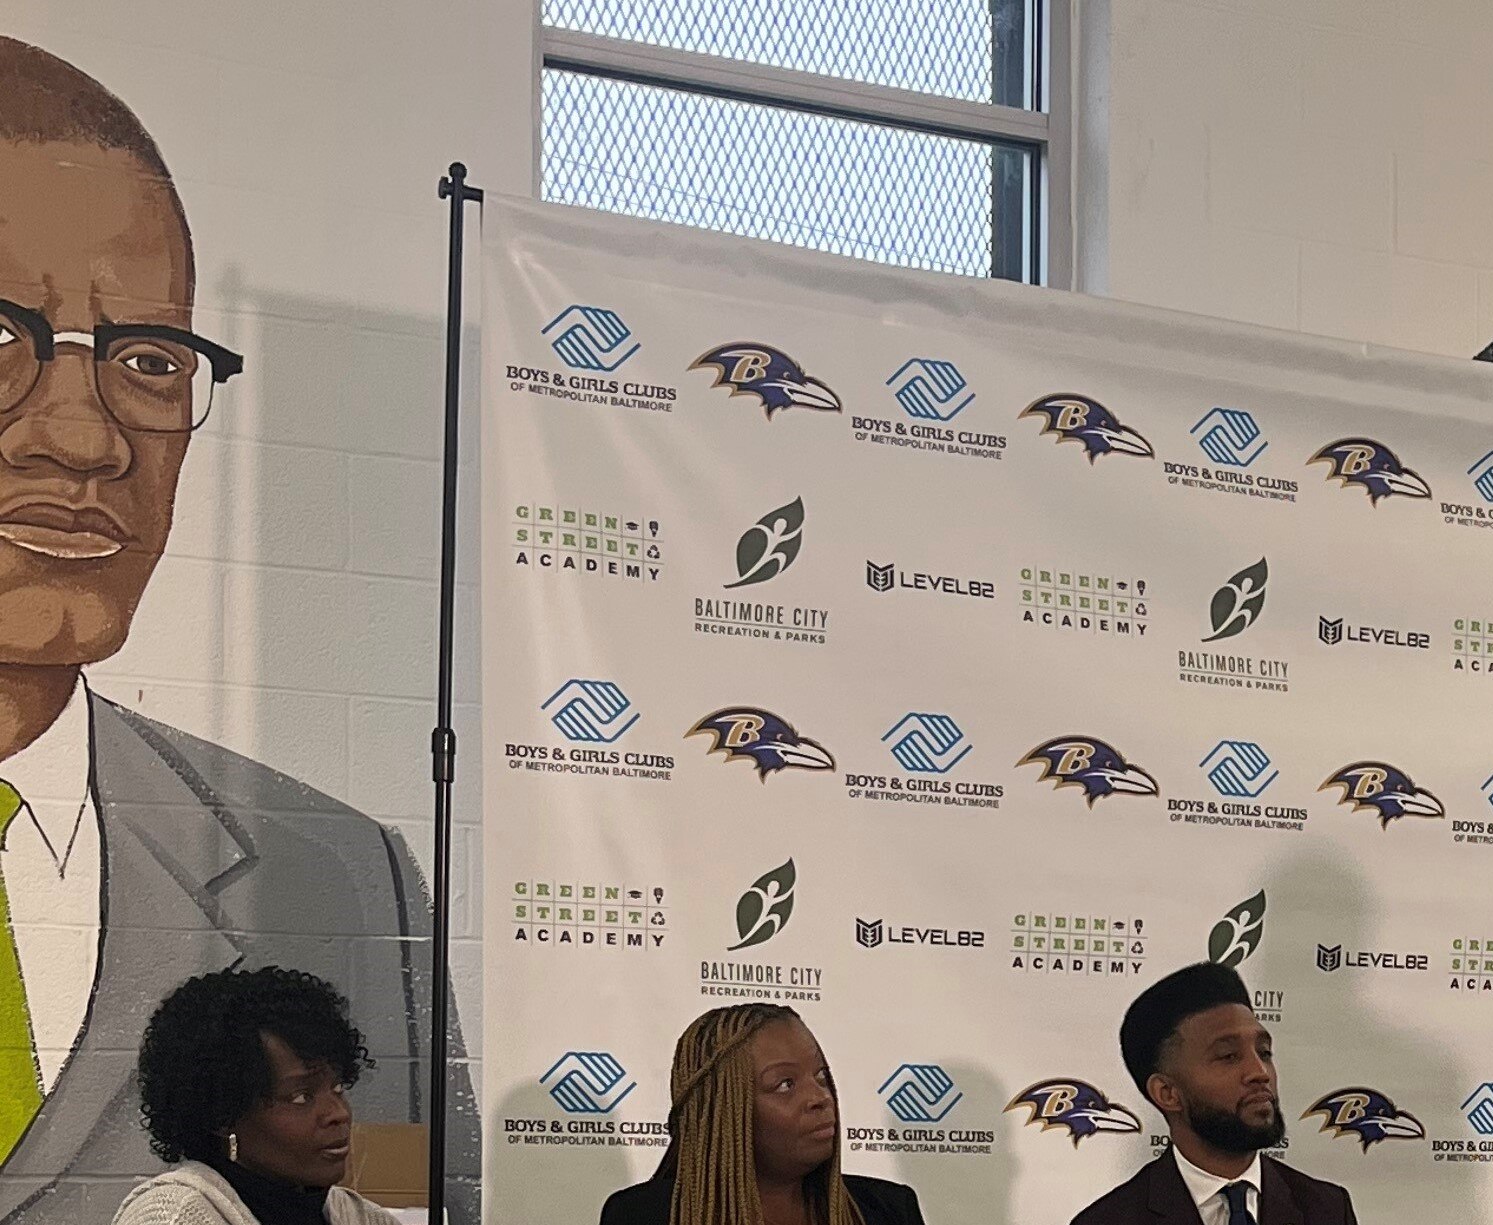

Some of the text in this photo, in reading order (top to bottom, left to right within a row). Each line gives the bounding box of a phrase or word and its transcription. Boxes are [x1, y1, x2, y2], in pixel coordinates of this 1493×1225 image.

[507, 365, 676, 401] BOYS & GIRLS CLUBS
[511, 383, 672, 412] OF METROPOLITAN BALTIMORE
[852, 416, 1006, 449] BOYS & GIRLS CLUBS
[855, 432, 1001, 460] OF METROPOLITAN BALTIMORE
[1164, 462, 1298, 492] BOYS & GIRLS CLUBS
[516, 506, 618, 529] GREEN
[1440, 503, 1472, 518] BOYS
[1476, 507, 1485, 519] &
[517, 529, 638, 555] STREET
[517, 552, 659, 581] ACADEMY
[901, 572, 994, 598] LEVEL82
[1020, 569, 1109, 591] GREEN
[1022, 589, 1128, 613] STREET
[696, 598, 828, 628] BALTIMORE CITY
[1024, 611, 1147, 635] ACADEMY
[696, 623, 769, 639] RECREATION
[786, 632, 825, 643] PARKS
[1348, 626, 1429, 648] LEVEL82
[1179, 651, 1288, 678] BALTIMORE CITY
[1180, 674, 1242, 688] RECREATION
[1256, 681, 1288, 692] PARKS
[506, 744, 674, 768] BOYS & GIRLS CLUBS
[509, 761, 671, 780] OF METROPOLITAN BALTIMORE
[845, 774, 1003, 797] BOYS & GIRLS CLUBS
[849, 789, 999, 809] OF METROPOLITAN BALTIMORE
[1168, 800, 1308, 820] BOYS & GIRLS CLUBS
[1170, 814, 1304, 831] OF METROPOLITAN BALTIMORE
[1452, 820, 1484, 834] BOYS
[1454, 834, 1464, 843] OF
[515, 882, 618, 900] GREEN
[515, 906, 641, 924] STREET
[1014, 914, 1105, 931] GREEN
[515, 929, 664, 947] ACADEMY
[888, 928, 984, 947] LEVEL82
[1014, 935, 1124, 953] STREET
[1013, 955, 1142, 974] ACADEMY
[1346, 952, 1427, 970] LEVEL82
[701, 962, 822, 986] BALTIMORE CITY
[701, 986, 771, 998] RECREATION
[785, 990, 820, 1001] PARKS
[1255, 991, 1283, 1008] CITY
[505, 1120, 546, 1132] BOYS
[551, 1121, 563, 1132] &
[568, 1121, 614, 1133] GIRLS
[847, 1128, 993, 1143] BOYS & GIRLS CLUBS
[508, 1135, 667, 1147] OF METROPOLITAN BALTIMORE
[850, 1143, 991, 1154] OF METROPOLITAN BALTIMORE
[1432, 1140, 1464, 1152] BOYS
[1467, 1141, 1476, 1152] &
